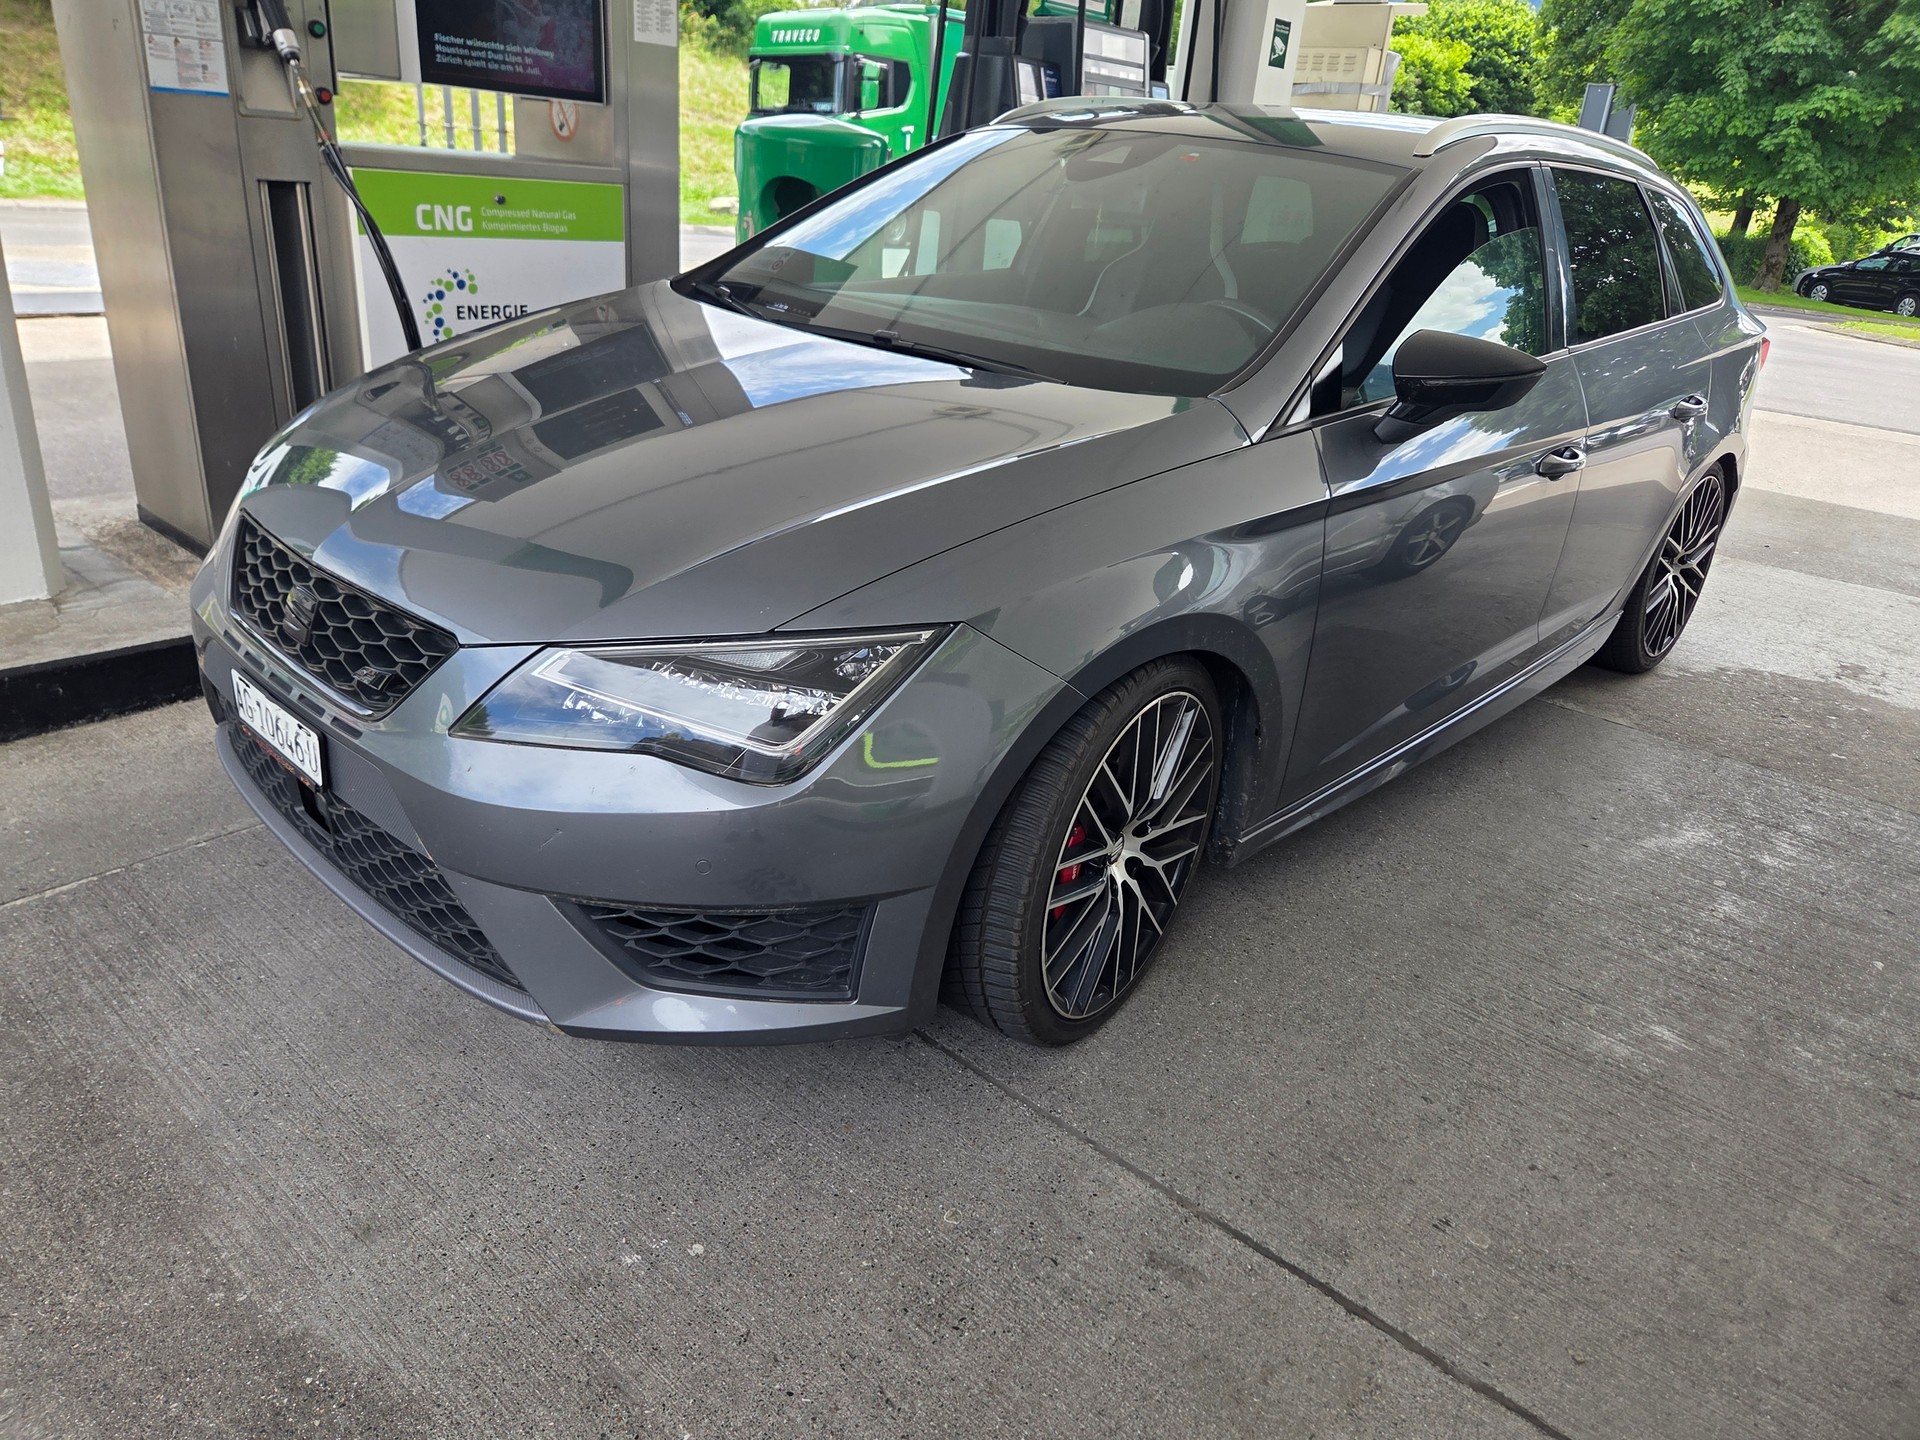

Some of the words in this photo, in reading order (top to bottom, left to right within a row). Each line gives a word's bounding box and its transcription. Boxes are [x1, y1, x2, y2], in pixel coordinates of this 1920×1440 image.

[771, 28, 821, 43] TRAVECO
[471, 49, 486, 58] und
[505, 43, 523, 53] sich
[416, 204, 473, 232] CNG
[481, 207, 530, 218] Compressed
[532, 210, 560, 220] Natural
[562, 211, 577, 220] Gas
[482, 220, 541, 232] Komprimiertes
[543, 222, 568, 234] Biogas
